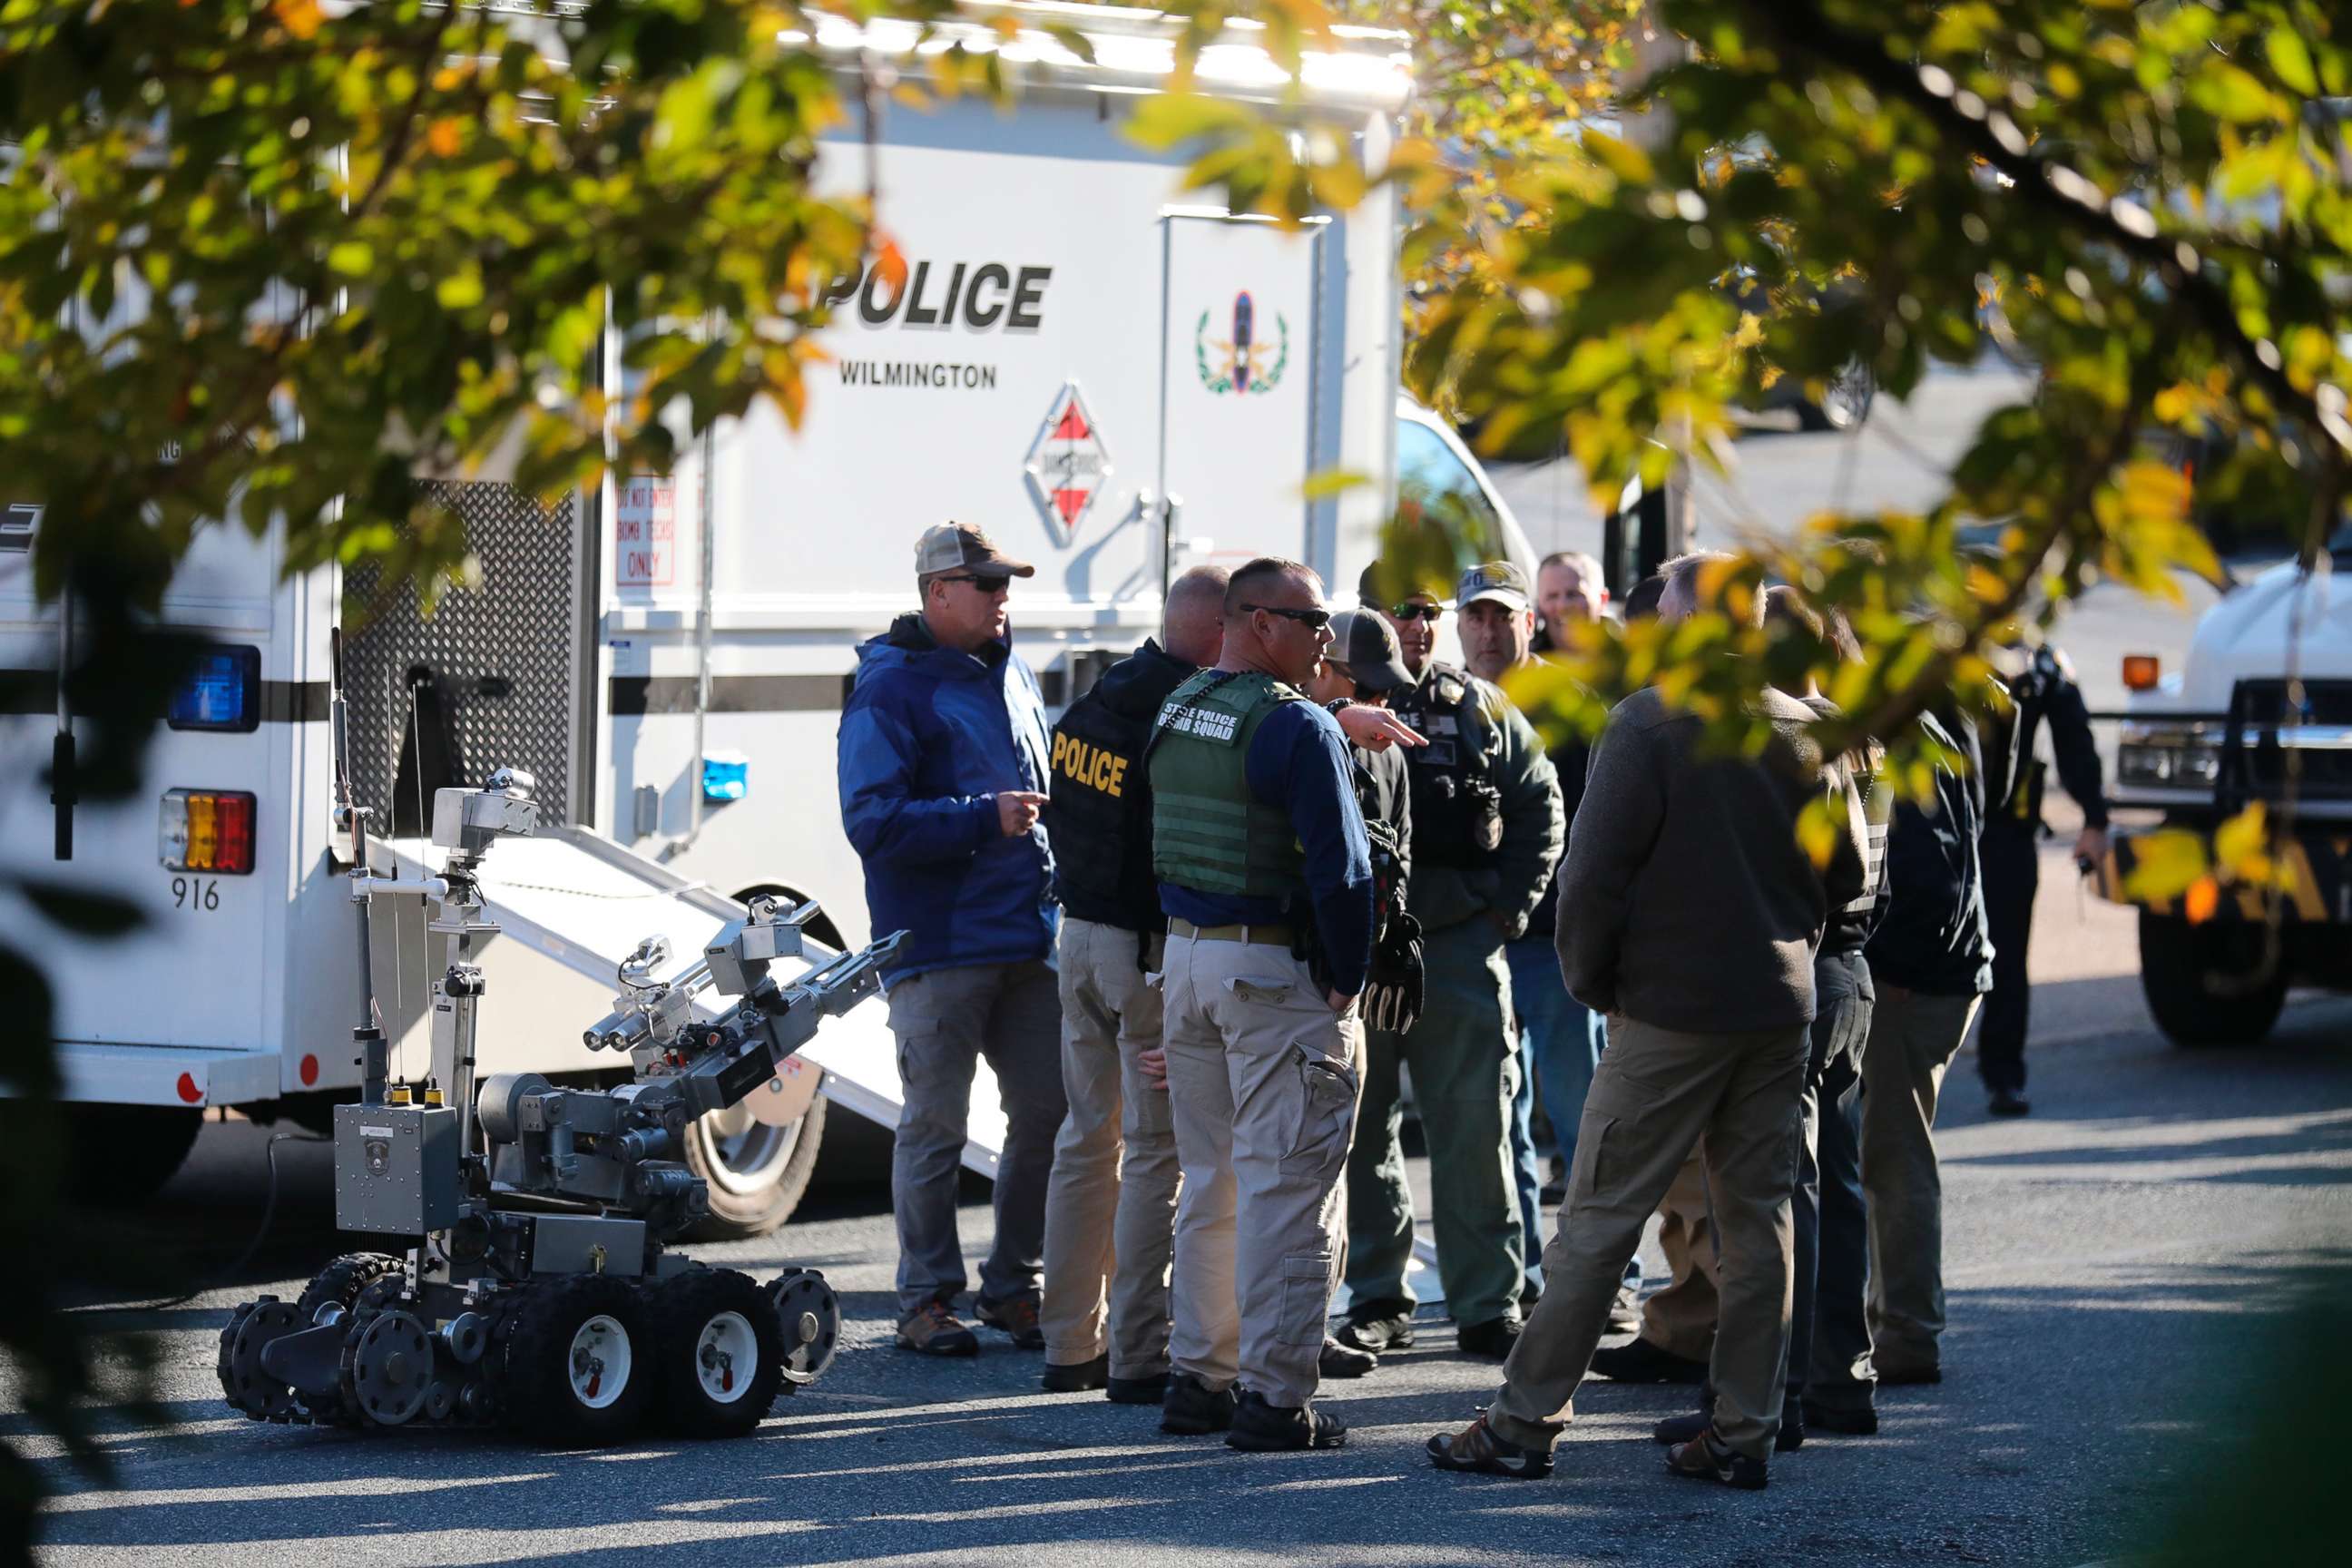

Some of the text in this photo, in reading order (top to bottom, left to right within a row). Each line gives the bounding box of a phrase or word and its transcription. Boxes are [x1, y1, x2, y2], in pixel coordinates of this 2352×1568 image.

[840, 361, 996, 388] WILMINGTON
[617, 520, 640, 542] BOMB
[627, 551, 660, 578] ONLY
[1192, 720, 1234, 741] SQUAD
[1197, 709, 1238, 728] POLICE
[1051, 730, 1129, 798] POLICE
[172, 877, 220, 911] 916
